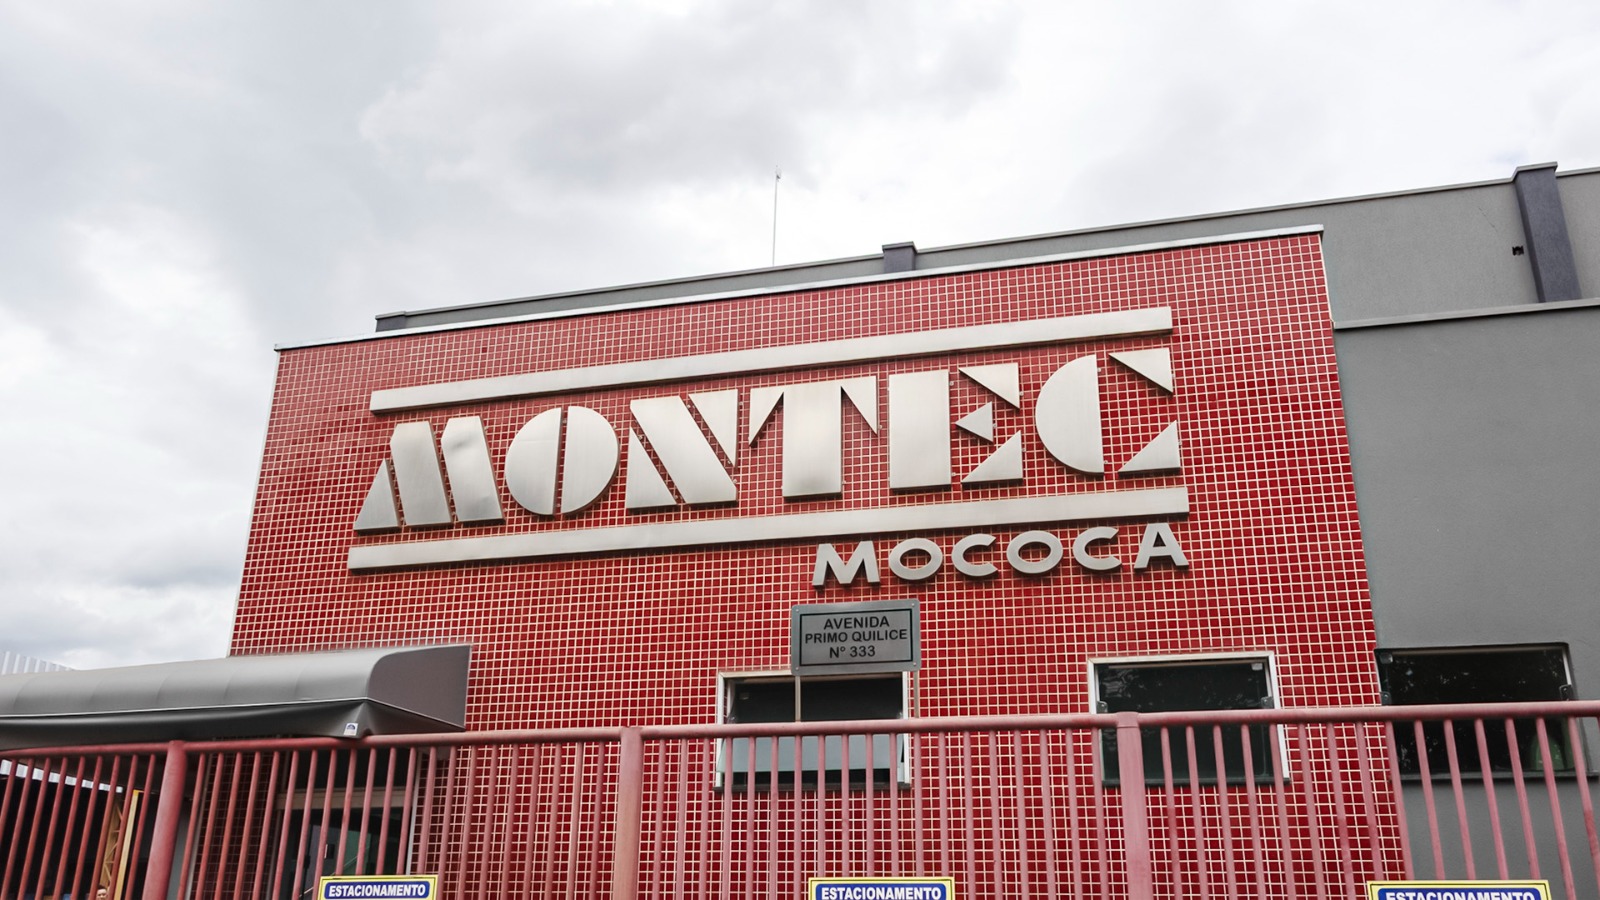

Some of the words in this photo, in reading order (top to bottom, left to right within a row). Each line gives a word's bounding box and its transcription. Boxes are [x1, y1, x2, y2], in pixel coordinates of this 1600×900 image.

[353, 346, 1182, 533] MONTEC
[812, 522, 1190, 588] MOCOCA
[823, 616, 890, 630] AVENIDA
[805, 632, 848, 644] PRIMO
[851, 629, 908, 642] QUILICE
[849, 645, 876, 657] 333
[328, 884, 426, 897] ESTACIONAMENTO
[821, 886, 942, 900] ESTACIONAMENTO
[1385, 891, 1536, 900] ESTACIONAMENTO
